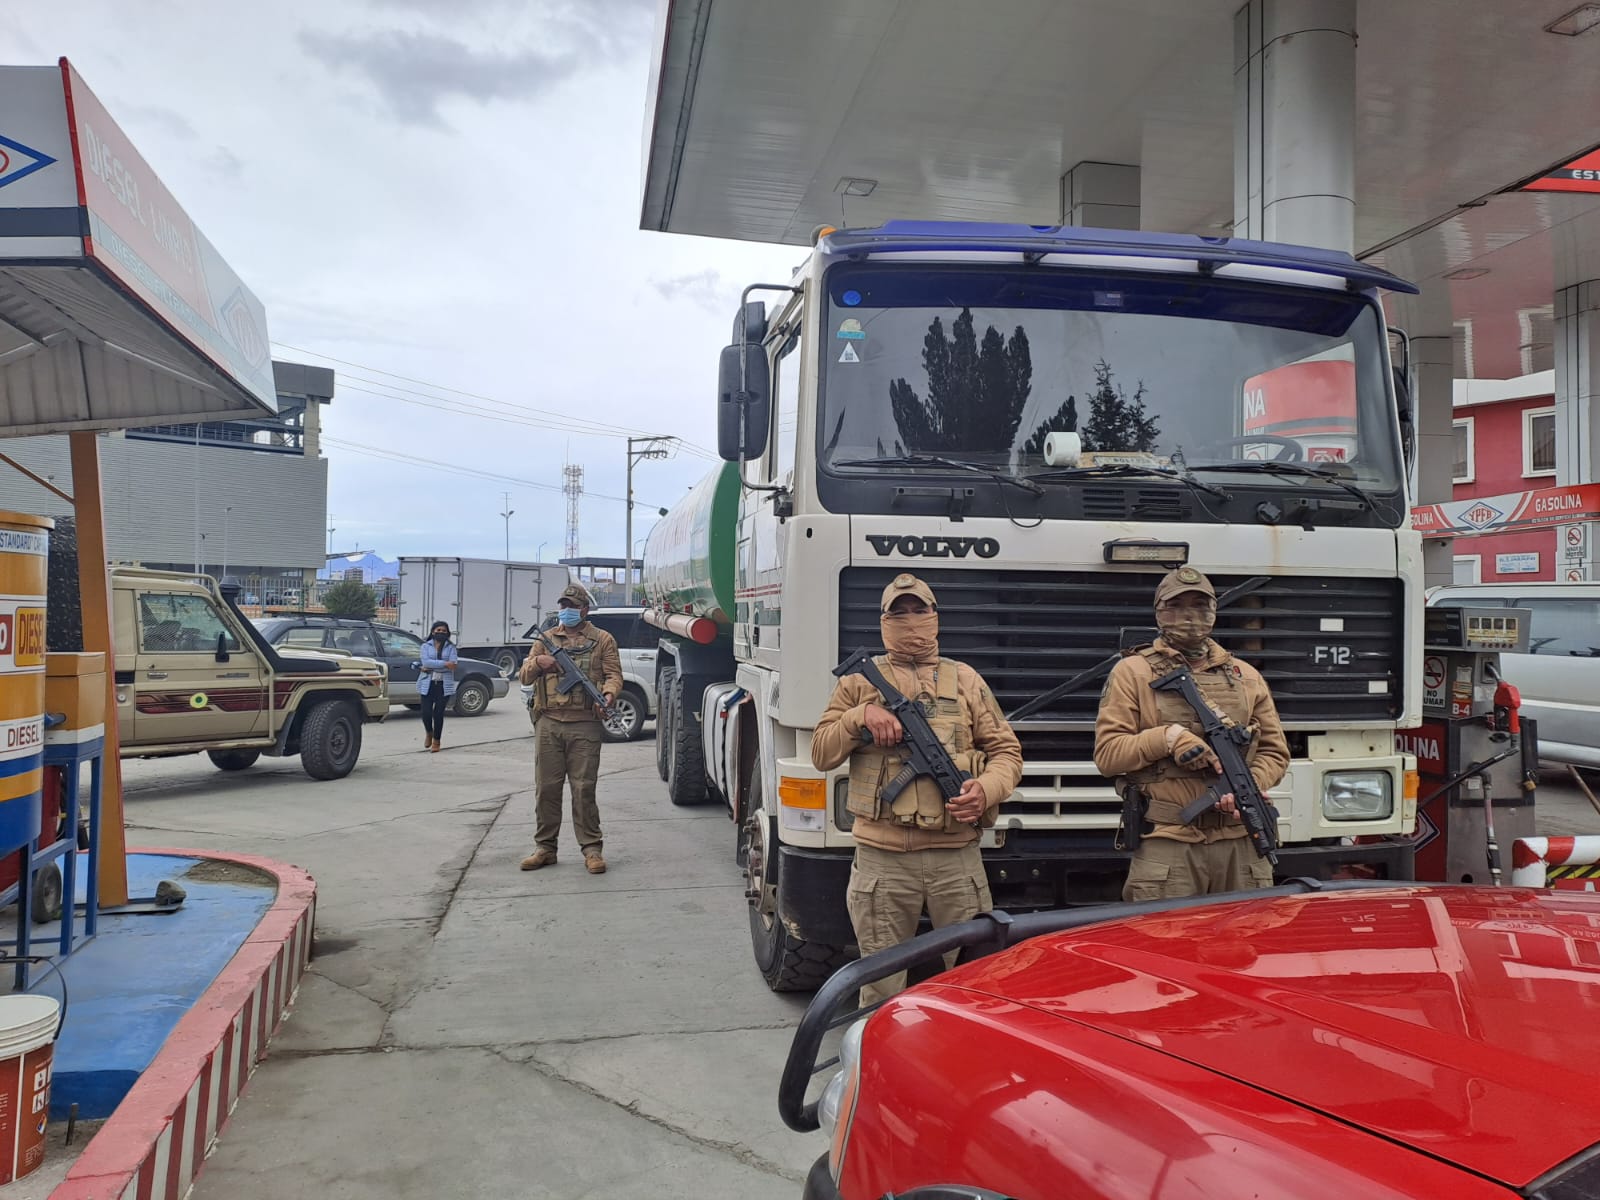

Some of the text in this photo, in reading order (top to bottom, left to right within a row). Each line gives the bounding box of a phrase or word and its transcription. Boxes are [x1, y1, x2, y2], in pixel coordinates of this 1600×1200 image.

[84, 122, 147, 227] DIESEL
[1535, 493, 1582, 513] GASOLINA
[1469, 507, 1492, 523] YPFB
[866, 534, 1000, 558] VOLVO
[1315, 646, 1350, 665] F12
[1424, 698, 1444, 706] UMAR
[1452, 703, 1470, 715] B-4
[8, 724, 39, 747] DIESEL
[1395, 734, 1440, 760] OLINA
